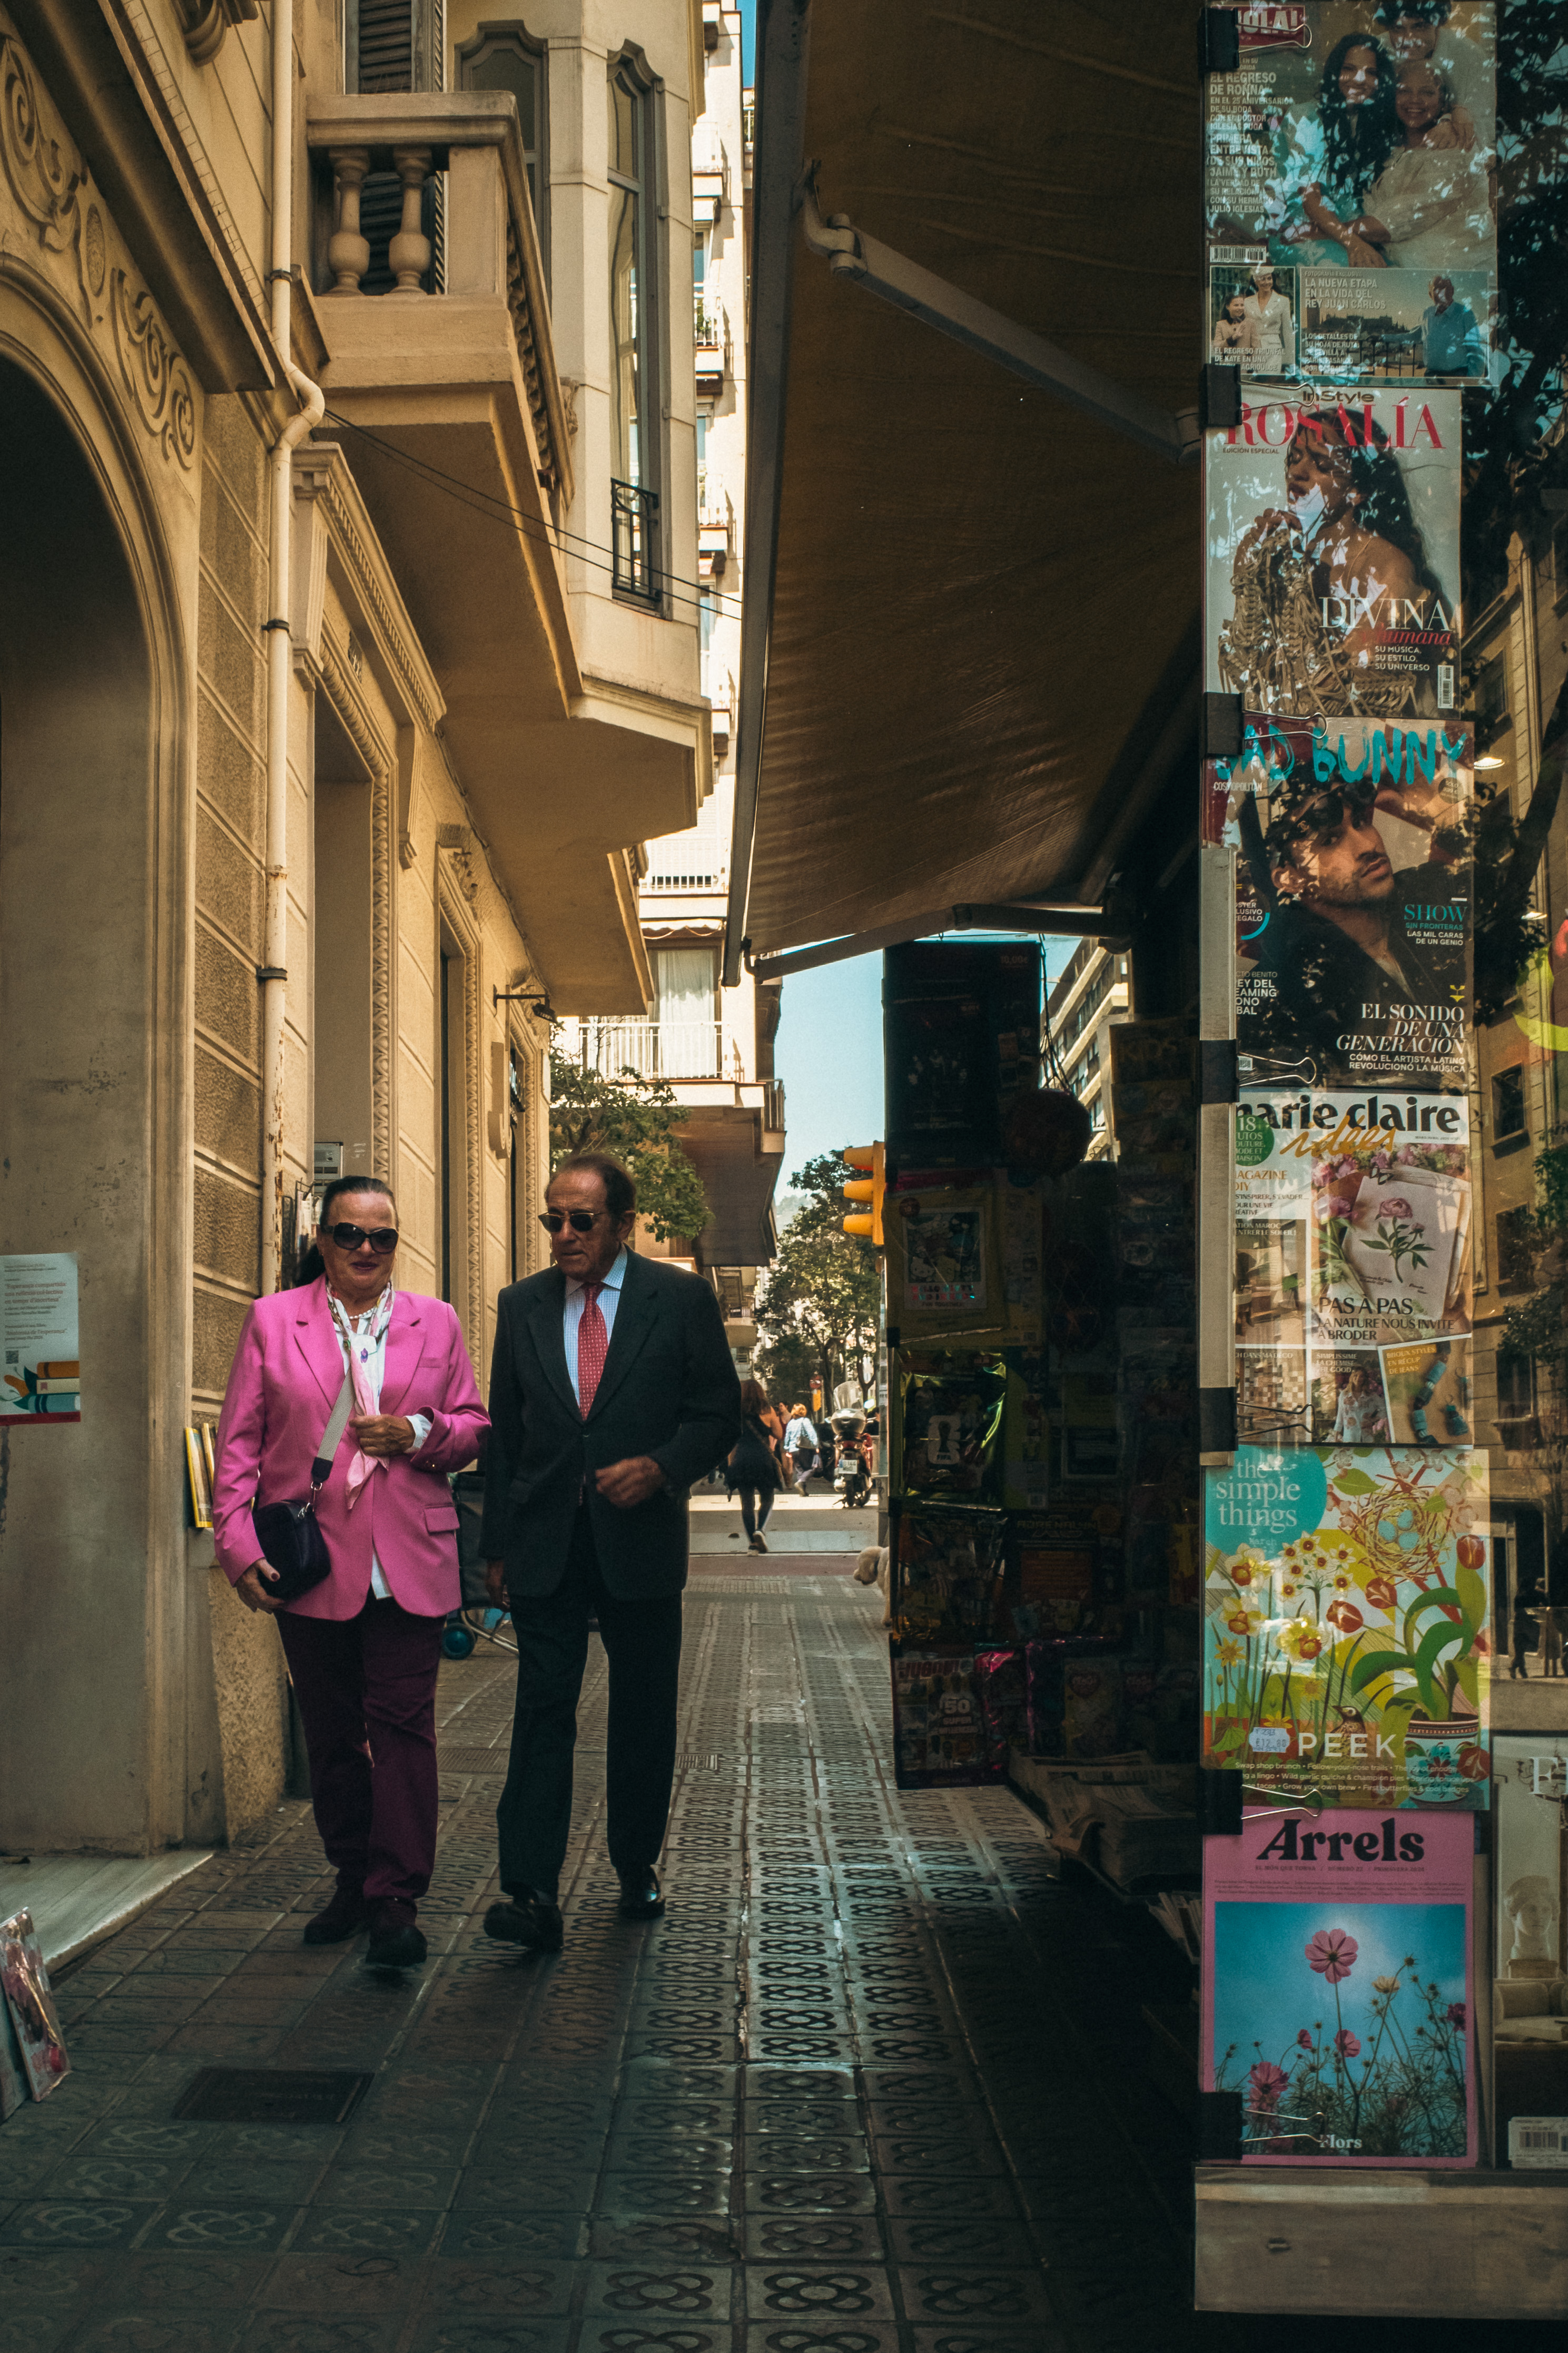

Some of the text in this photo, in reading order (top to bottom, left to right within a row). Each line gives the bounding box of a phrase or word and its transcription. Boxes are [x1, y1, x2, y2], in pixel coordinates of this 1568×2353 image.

[1238, 10, 1297, 34] OLA!
[1210, 72, 1277, 83] EL REGRESO
[1210, 84, 1265, 95] DE RONNA
[1210, 145, 1269, 154] ENTREVISTA
[1233, 205, 1264, 213] IGLESIAS
[1305, 278, 1378, 288] LA NUEVA ETAPA
[1305, 289, 1373, 299] EN LA VIDA DEL
[1305, 299, 1386, 310] REY JUAN CARLOS
[1303, 390, 1375, 404] InStyle
[1223, 396, 1446, 449] ROSALÍA
[1319, 597, 1456, 631] DIVINA
[1388, 644, 1422, 654] MÚSICA,
[1313, 727, 1467, 785] BUNNY
[1214, 781, 1264, 792] COSMOPOLITAN
[1404, 904, 1467, 922] SHOW
[1254, 979, 1275, 988] DEL
[1362, 1003, 1465, 1022] EL SONIDO
[1394, 1021, 1465, 1039] DE UNA
[1349, 1052, 1378, 1062] CÓMO
[1433, 1056, 1465, 1065] LATINO
[1349, 1061, 1414, 1071] REVOLUCIONÓ
[1431, 1062, 1465, 1073] MÚSICA
[1346, 1095, 1461, 1133] claire
[1239, 1116, 1256, 1131] 18
[1319, 1297, 1413, 1315] PAS PAS
[1318, 1318, 1455, 1329] LA NATURE NOUS INVITE
[1328, 1330, 1377, 1340] BRODER
[1237, 1458, 1268, 1478] the
[1216, 1476, 1301, 1507] simple
[1218, 1501, 1297, 1534] things
[944, 1699, 971, 1714] 50
[1298, 1732, 1396, 1758] PEEK
[1256, 1818, 1424, 1862] Arrels
[1319, 2134, 1363, 2149] Flors
